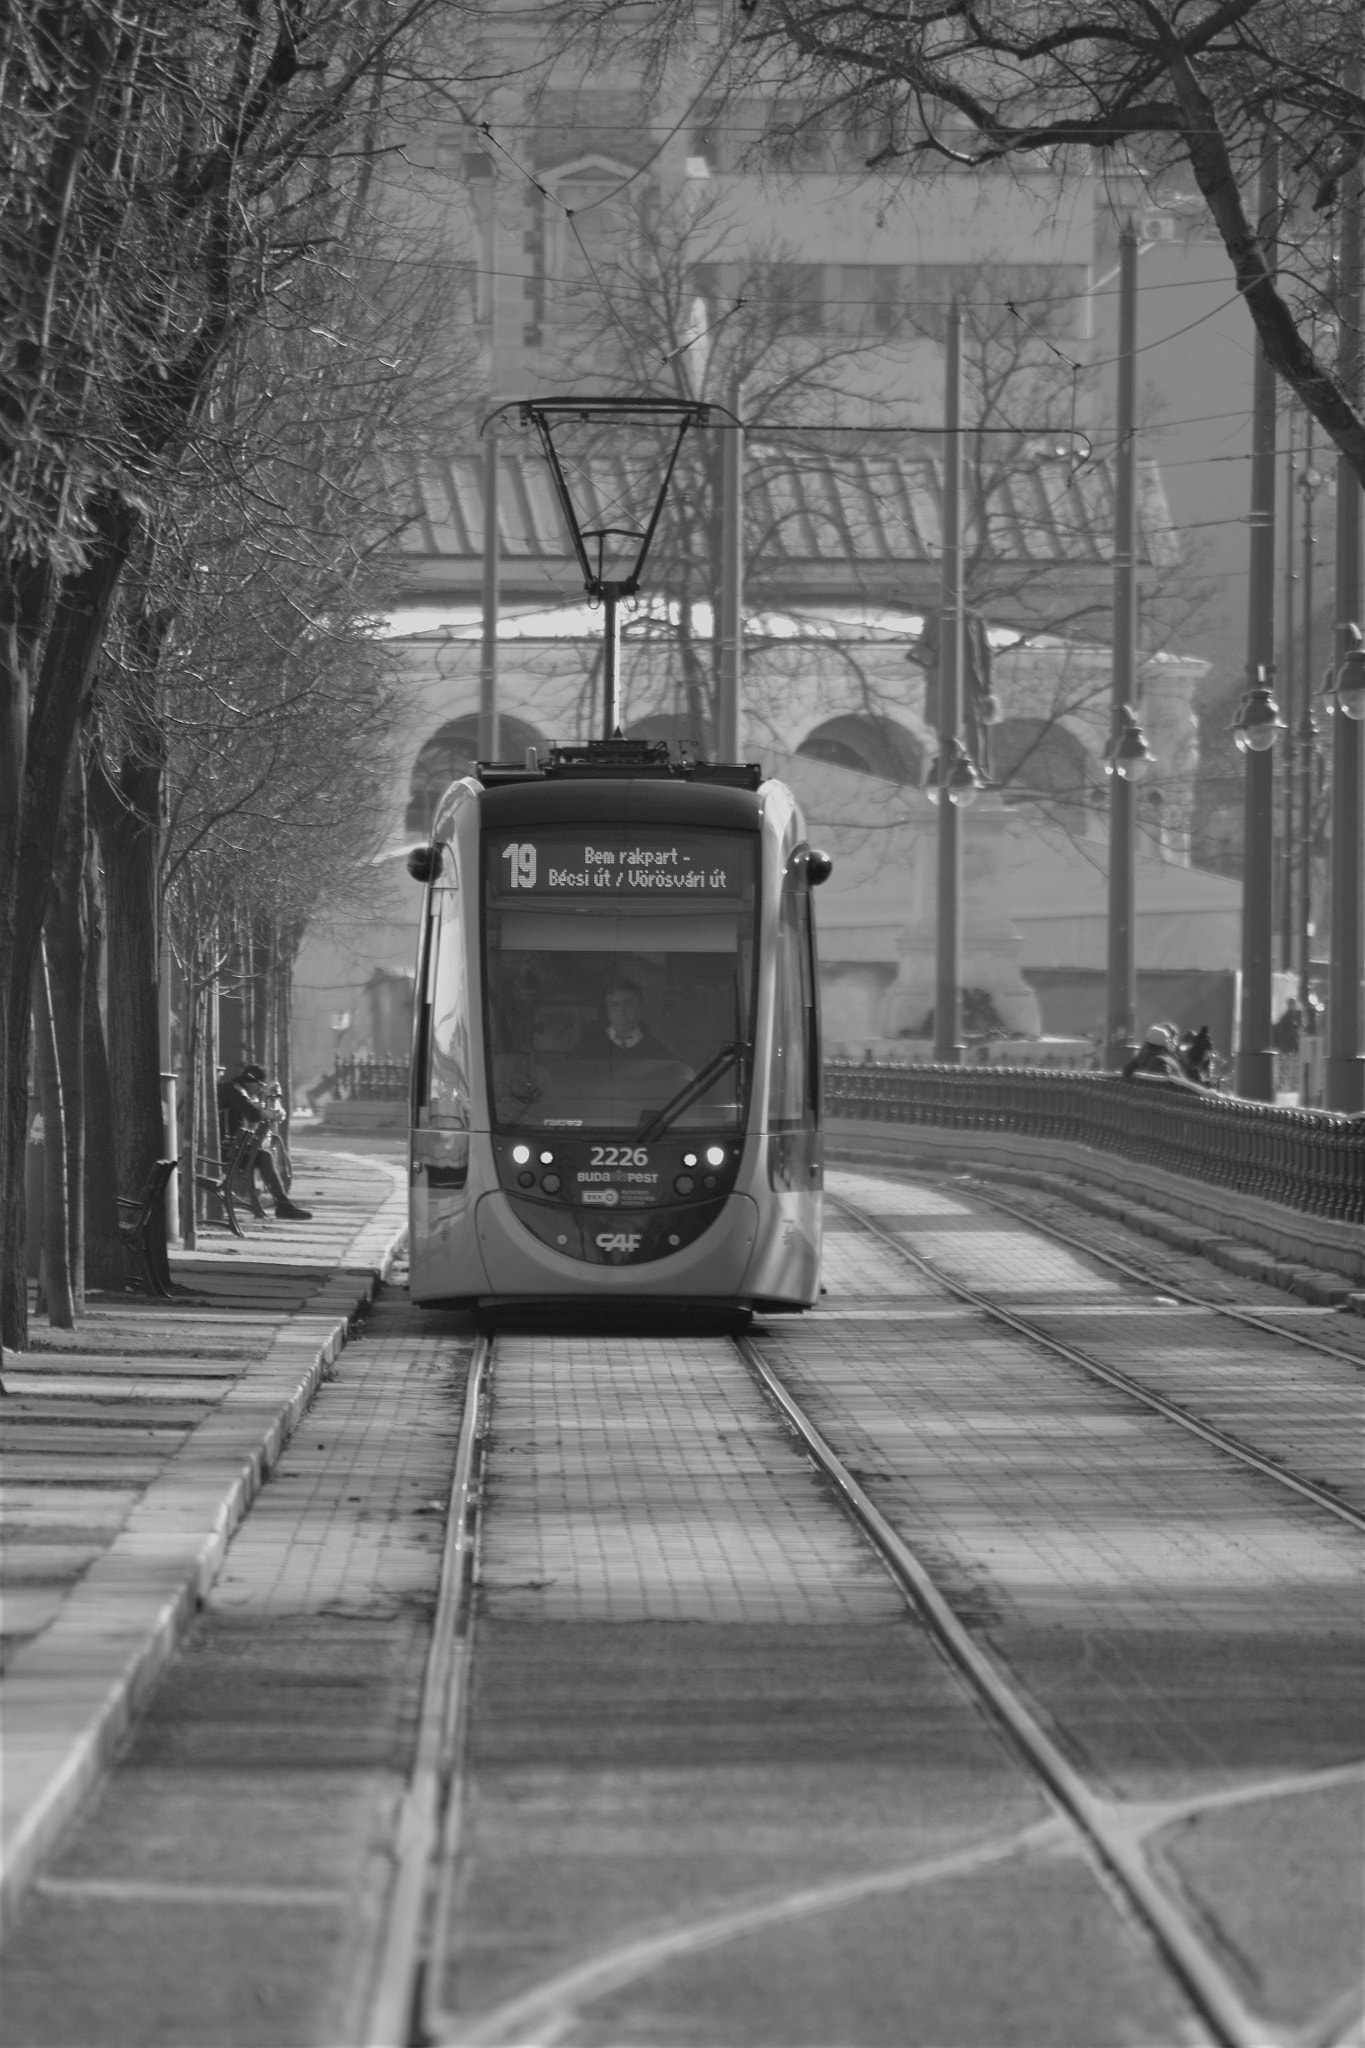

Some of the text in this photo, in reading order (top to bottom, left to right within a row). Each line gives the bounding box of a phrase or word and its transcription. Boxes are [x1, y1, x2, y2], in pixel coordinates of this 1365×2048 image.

[502, 843, 537, 888] 19
[584, 846, 614, 864] Bem
[619, 847, 678, 866] rakpart
[548, 868, 589, 887] Bécsi
[593, 867, 611, 887] út
[628, 870, 705, 888] Vörösvári
[709, 868, 727, 888] út
[590, 1147, 648, 1166] 2226
[595, 1233, 642, 1252] CAF
